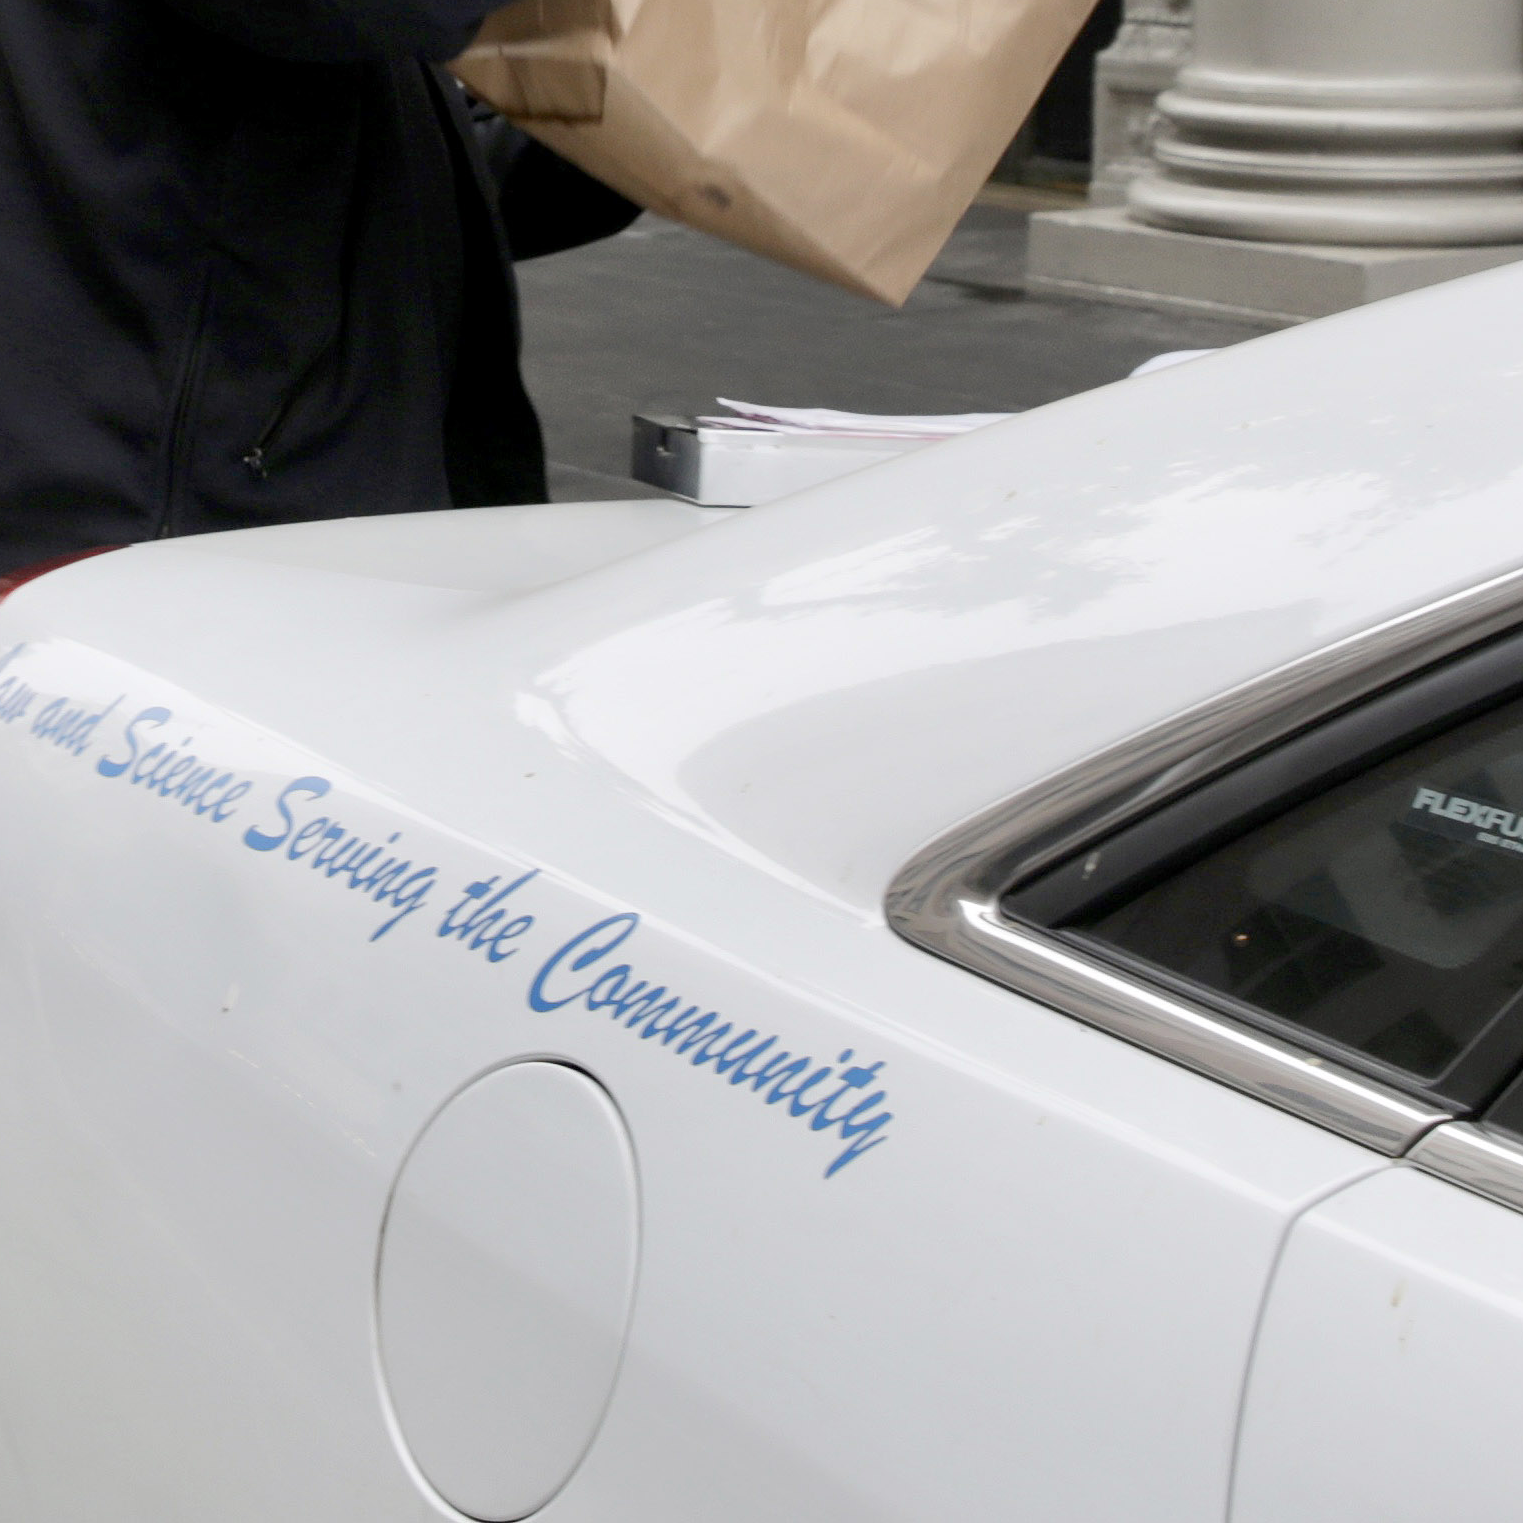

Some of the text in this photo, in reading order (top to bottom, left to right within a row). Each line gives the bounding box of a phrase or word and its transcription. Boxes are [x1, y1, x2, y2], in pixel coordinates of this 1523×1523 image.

[31, 693, 127, 757] and
[95, 706, 254, 824] Science
[242, 775, 439, 943] Serving
[437, 867, 543, 963] the
[527, 911, 894, 1179] Community
[1411, 787, 1523, 839] FLEXFU
